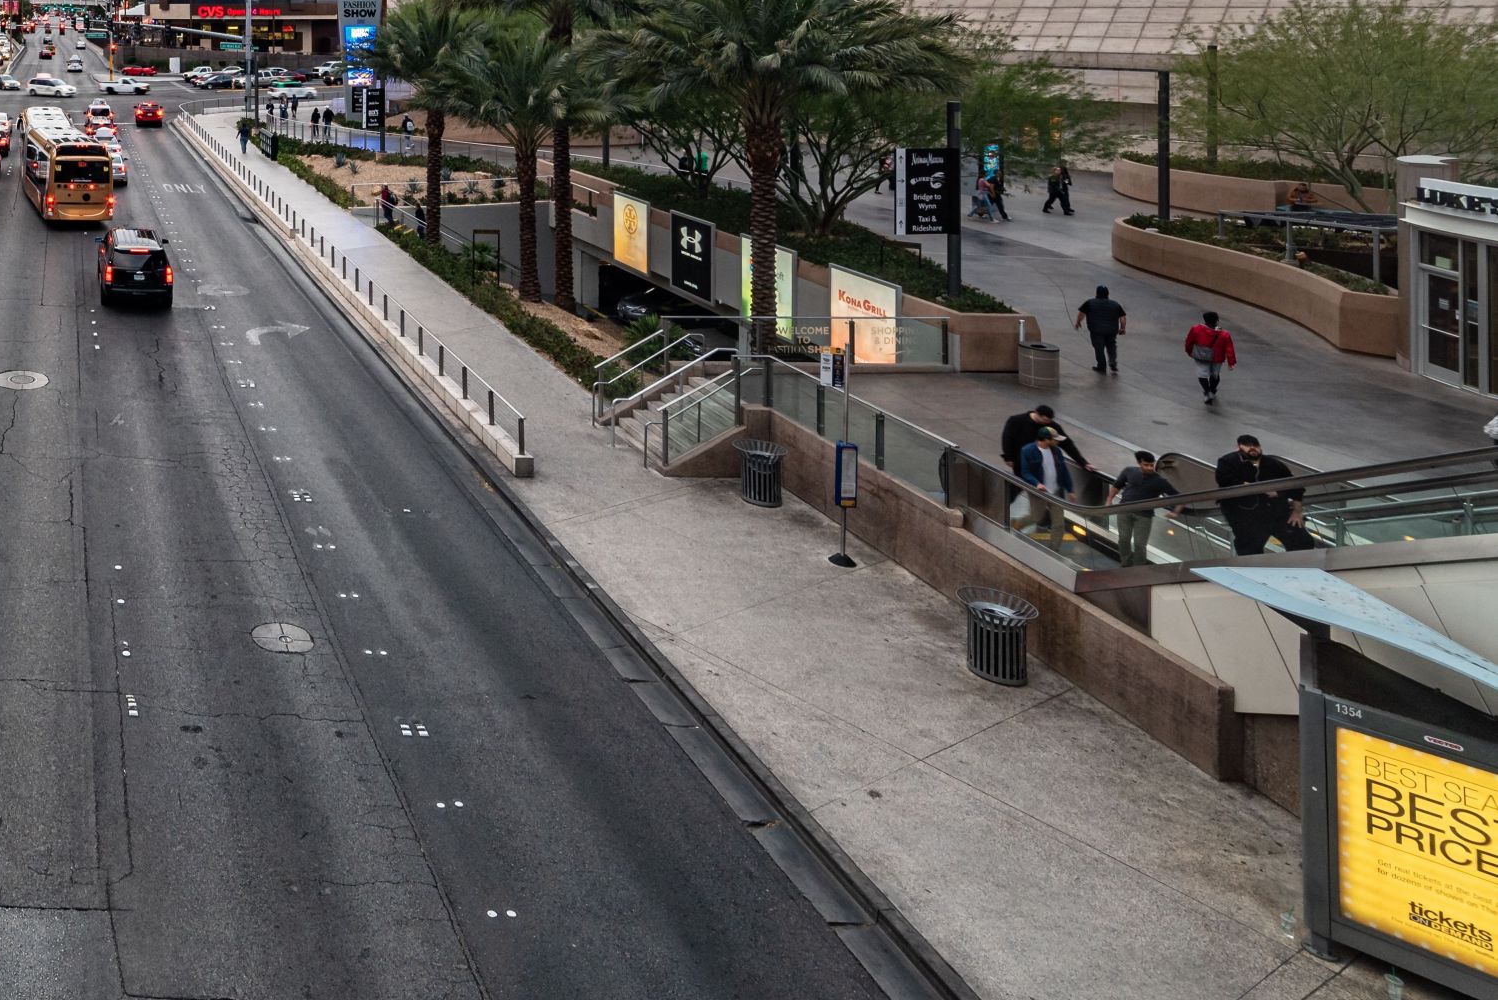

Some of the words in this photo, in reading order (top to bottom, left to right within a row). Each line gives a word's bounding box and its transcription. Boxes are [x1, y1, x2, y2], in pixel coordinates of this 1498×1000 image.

[198, 5, 224, 18] CVS
[343, 1, 377, 9] FASHION
[343, 9, 377, 18] SHOW
[162, 183, 206, 193] ONLY
[913, 193, 933, 202] Bridge
[918, 203, 937, 211] Wynn
[838, 289, 862, 309] KONA
[862, 300, 887, 317] GRILL
[777, 326, 830, 335] WELCOME
[870, 326, 920, 335] SHOPPIN
[797, 336, 811, 344] TO
[1334, 704, 1363, 719] 1354
[1364, 755, 1435, 794] BEST
[1366, 778, 1498, 847] BES
[1377, 859, 1392, 869] Get
[1395, 864, 1411, 874] real
[1413, 870, 1442, 886] tickets
[1377, 867, 1388, 876] for
[1391, 873, 1422, 888] dozens
[1435, 889, 1465, 903] shows
[1408, 901, 1493, 942] tickets
[1410, 914, 1429, 926] ON
[1431, 921, 1493, 951] DEMAND
